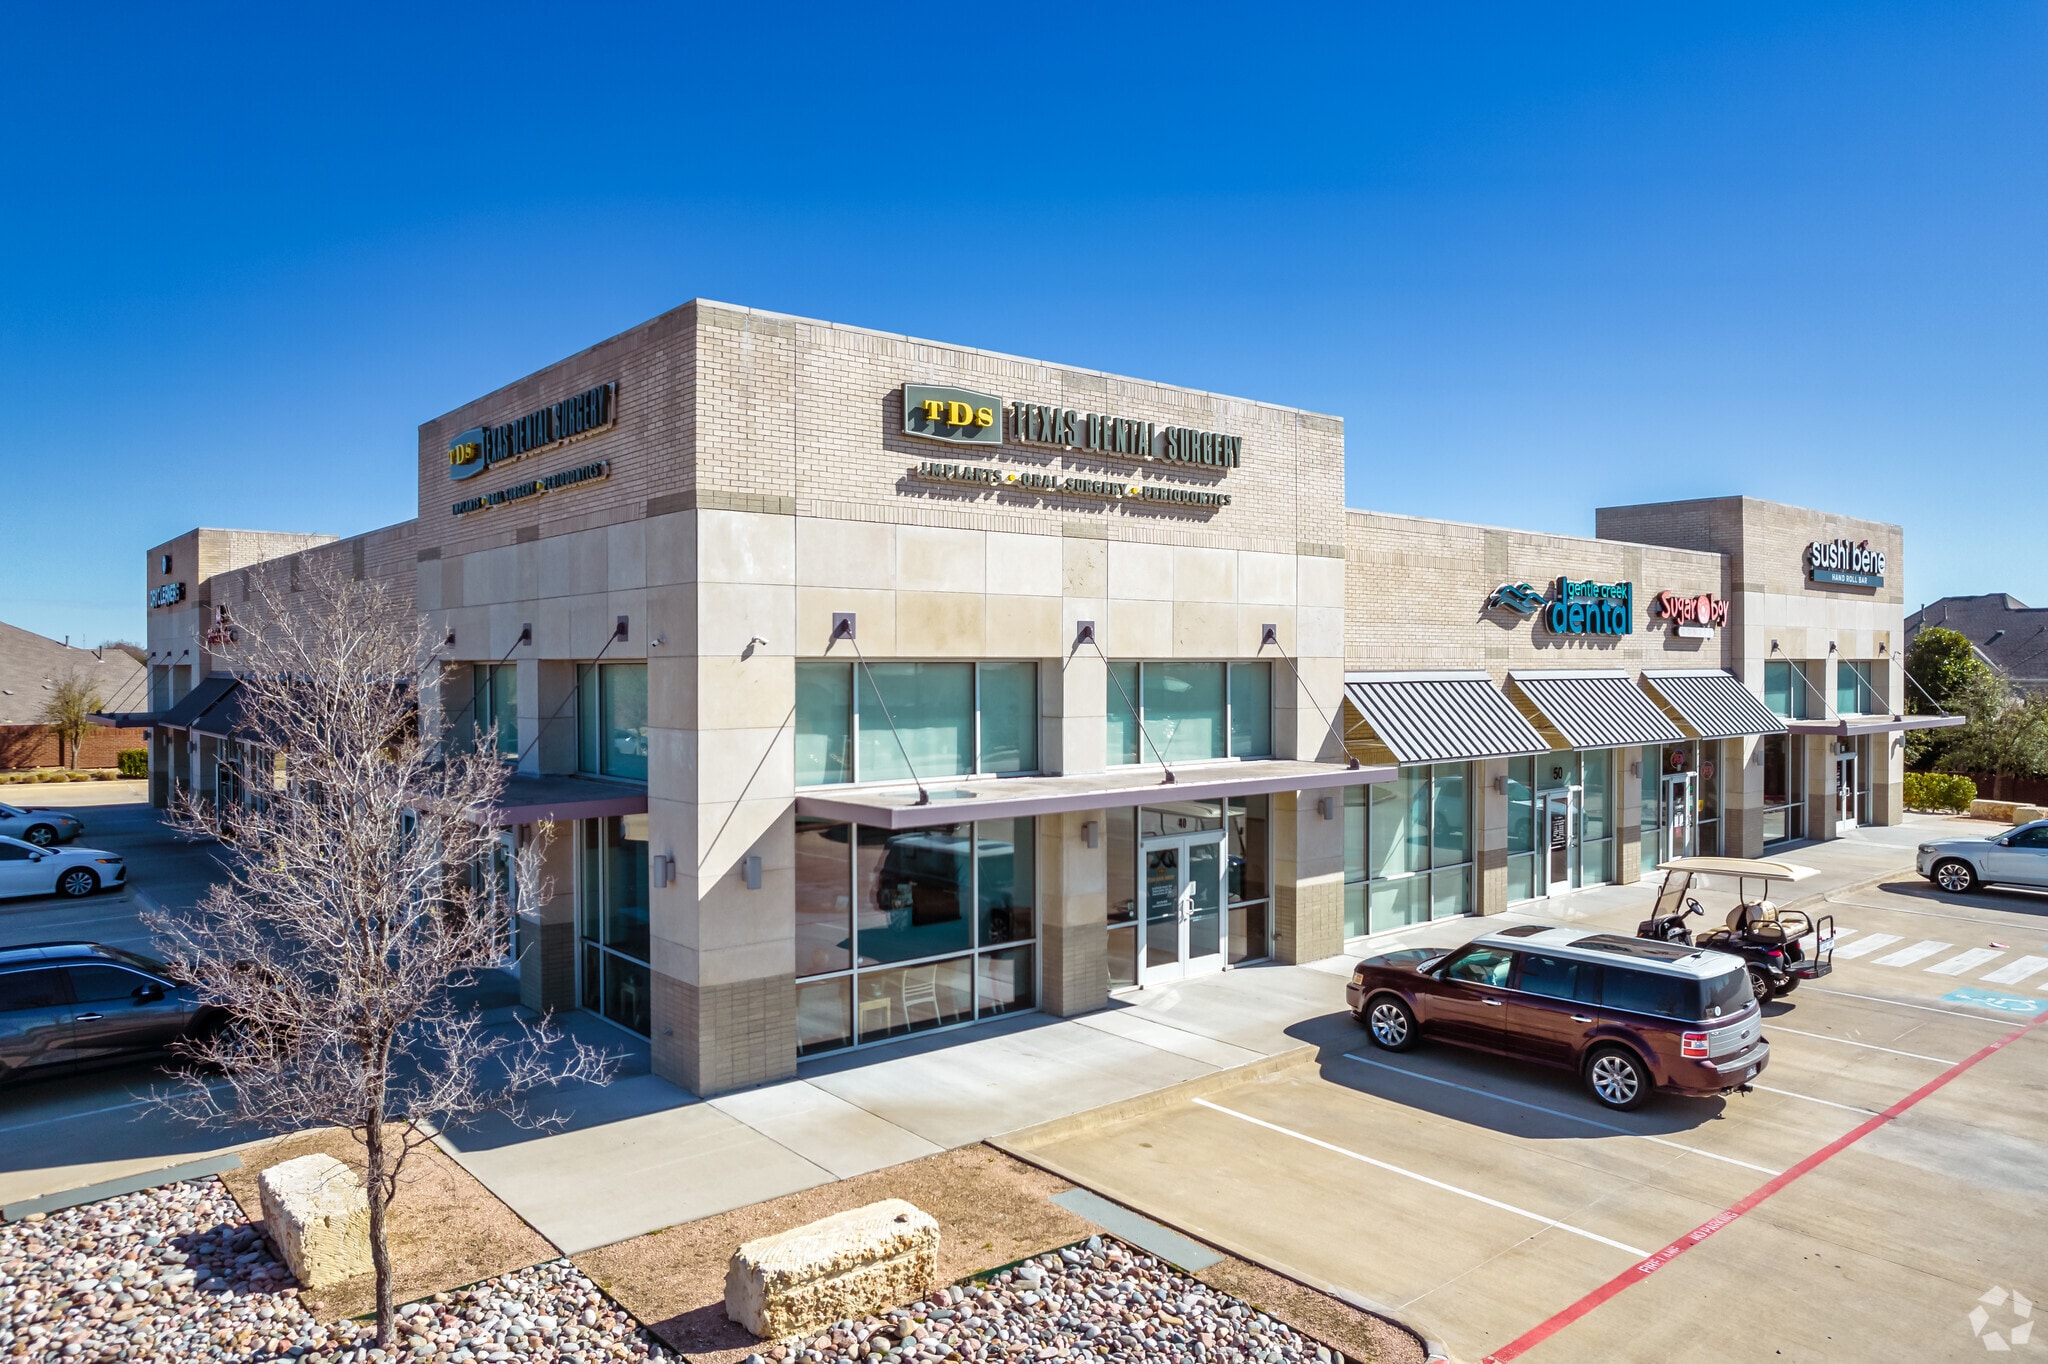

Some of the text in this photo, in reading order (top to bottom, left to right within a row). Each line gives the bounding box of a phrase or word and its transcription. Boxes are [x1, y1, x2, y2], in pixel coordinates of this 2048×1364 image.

[482, 385, 606, 469] TEXAS DENTAL SURGERY
[1011, 401, 1243, 469] TEXAS DENTAL SURGERY
[503, 481, 537, 502] SURGERY
[542, 463, 601, 490] PERIODONTICS
[921, 461, 1232, 506] IMPLANTS ORAL SURGERY PERIODONTICS
[1812, 539, 1850, 569] sushi
[1568, 580, 1628, 600] gentle creek
[1831, 573, 1868, 584] HAND ROLL BAR
[1553, 576, 1632, 635] dental
[1661, 590, 1697, 626] Sugar
[1553, 767, 1563, 780] 50
[1688, 1210, 1739, 1240] NO PARKING
